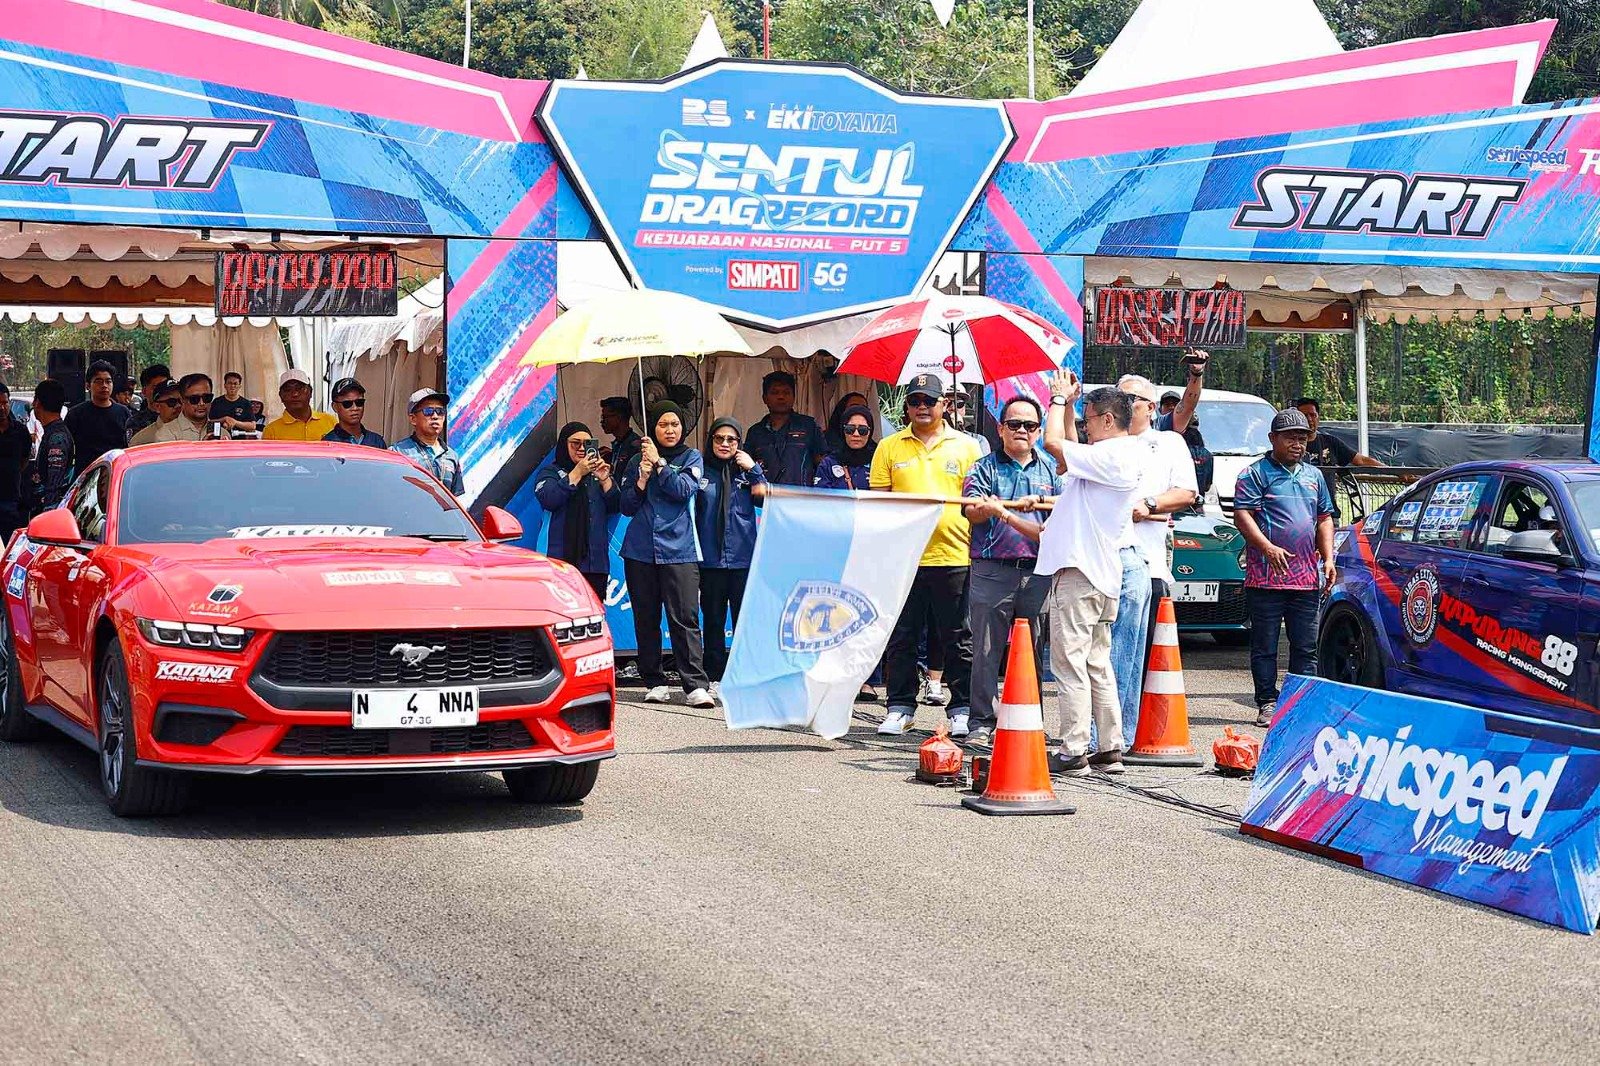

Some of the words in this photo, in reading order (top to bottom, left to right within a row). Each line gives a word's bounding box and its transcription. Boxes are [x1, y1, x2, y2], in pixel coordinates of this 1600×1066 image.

[0, 113, 268, 188] TART
[649, 138, 925, 198] SENTUL
[1233, 167, 1529, 238] START
[642, 232, 746, 248] KEJUARAAN
[750, 236, 833, 250] NASIONAL
[850, 238, 886, 251] PUT
[889, 239, 902, 252] 5
[685, 265, 713, 274] Powered
[730, 262, 798, 289] SIMPATI
[813, 262, 848, 287] 5G
[1183, 583, 1190, 596] 1
[1204, 584, 1218, 596] DY
[188, 601, 240, 615] KATANA
[1475, 638, 1507, 659] RACING
[1507, 654, 1568, 691] MANAGEMENT
[1540, 634, 1578, 677] 88
[155, 661, 240, 680] KATANA
[167, 674, 196, 682] RACING
[357, 693, 369, 715] N
[406, 693, 419, 714] 4
[439, 691, 474, 713] NNA
[1410, 818, 1551, 876] Management
